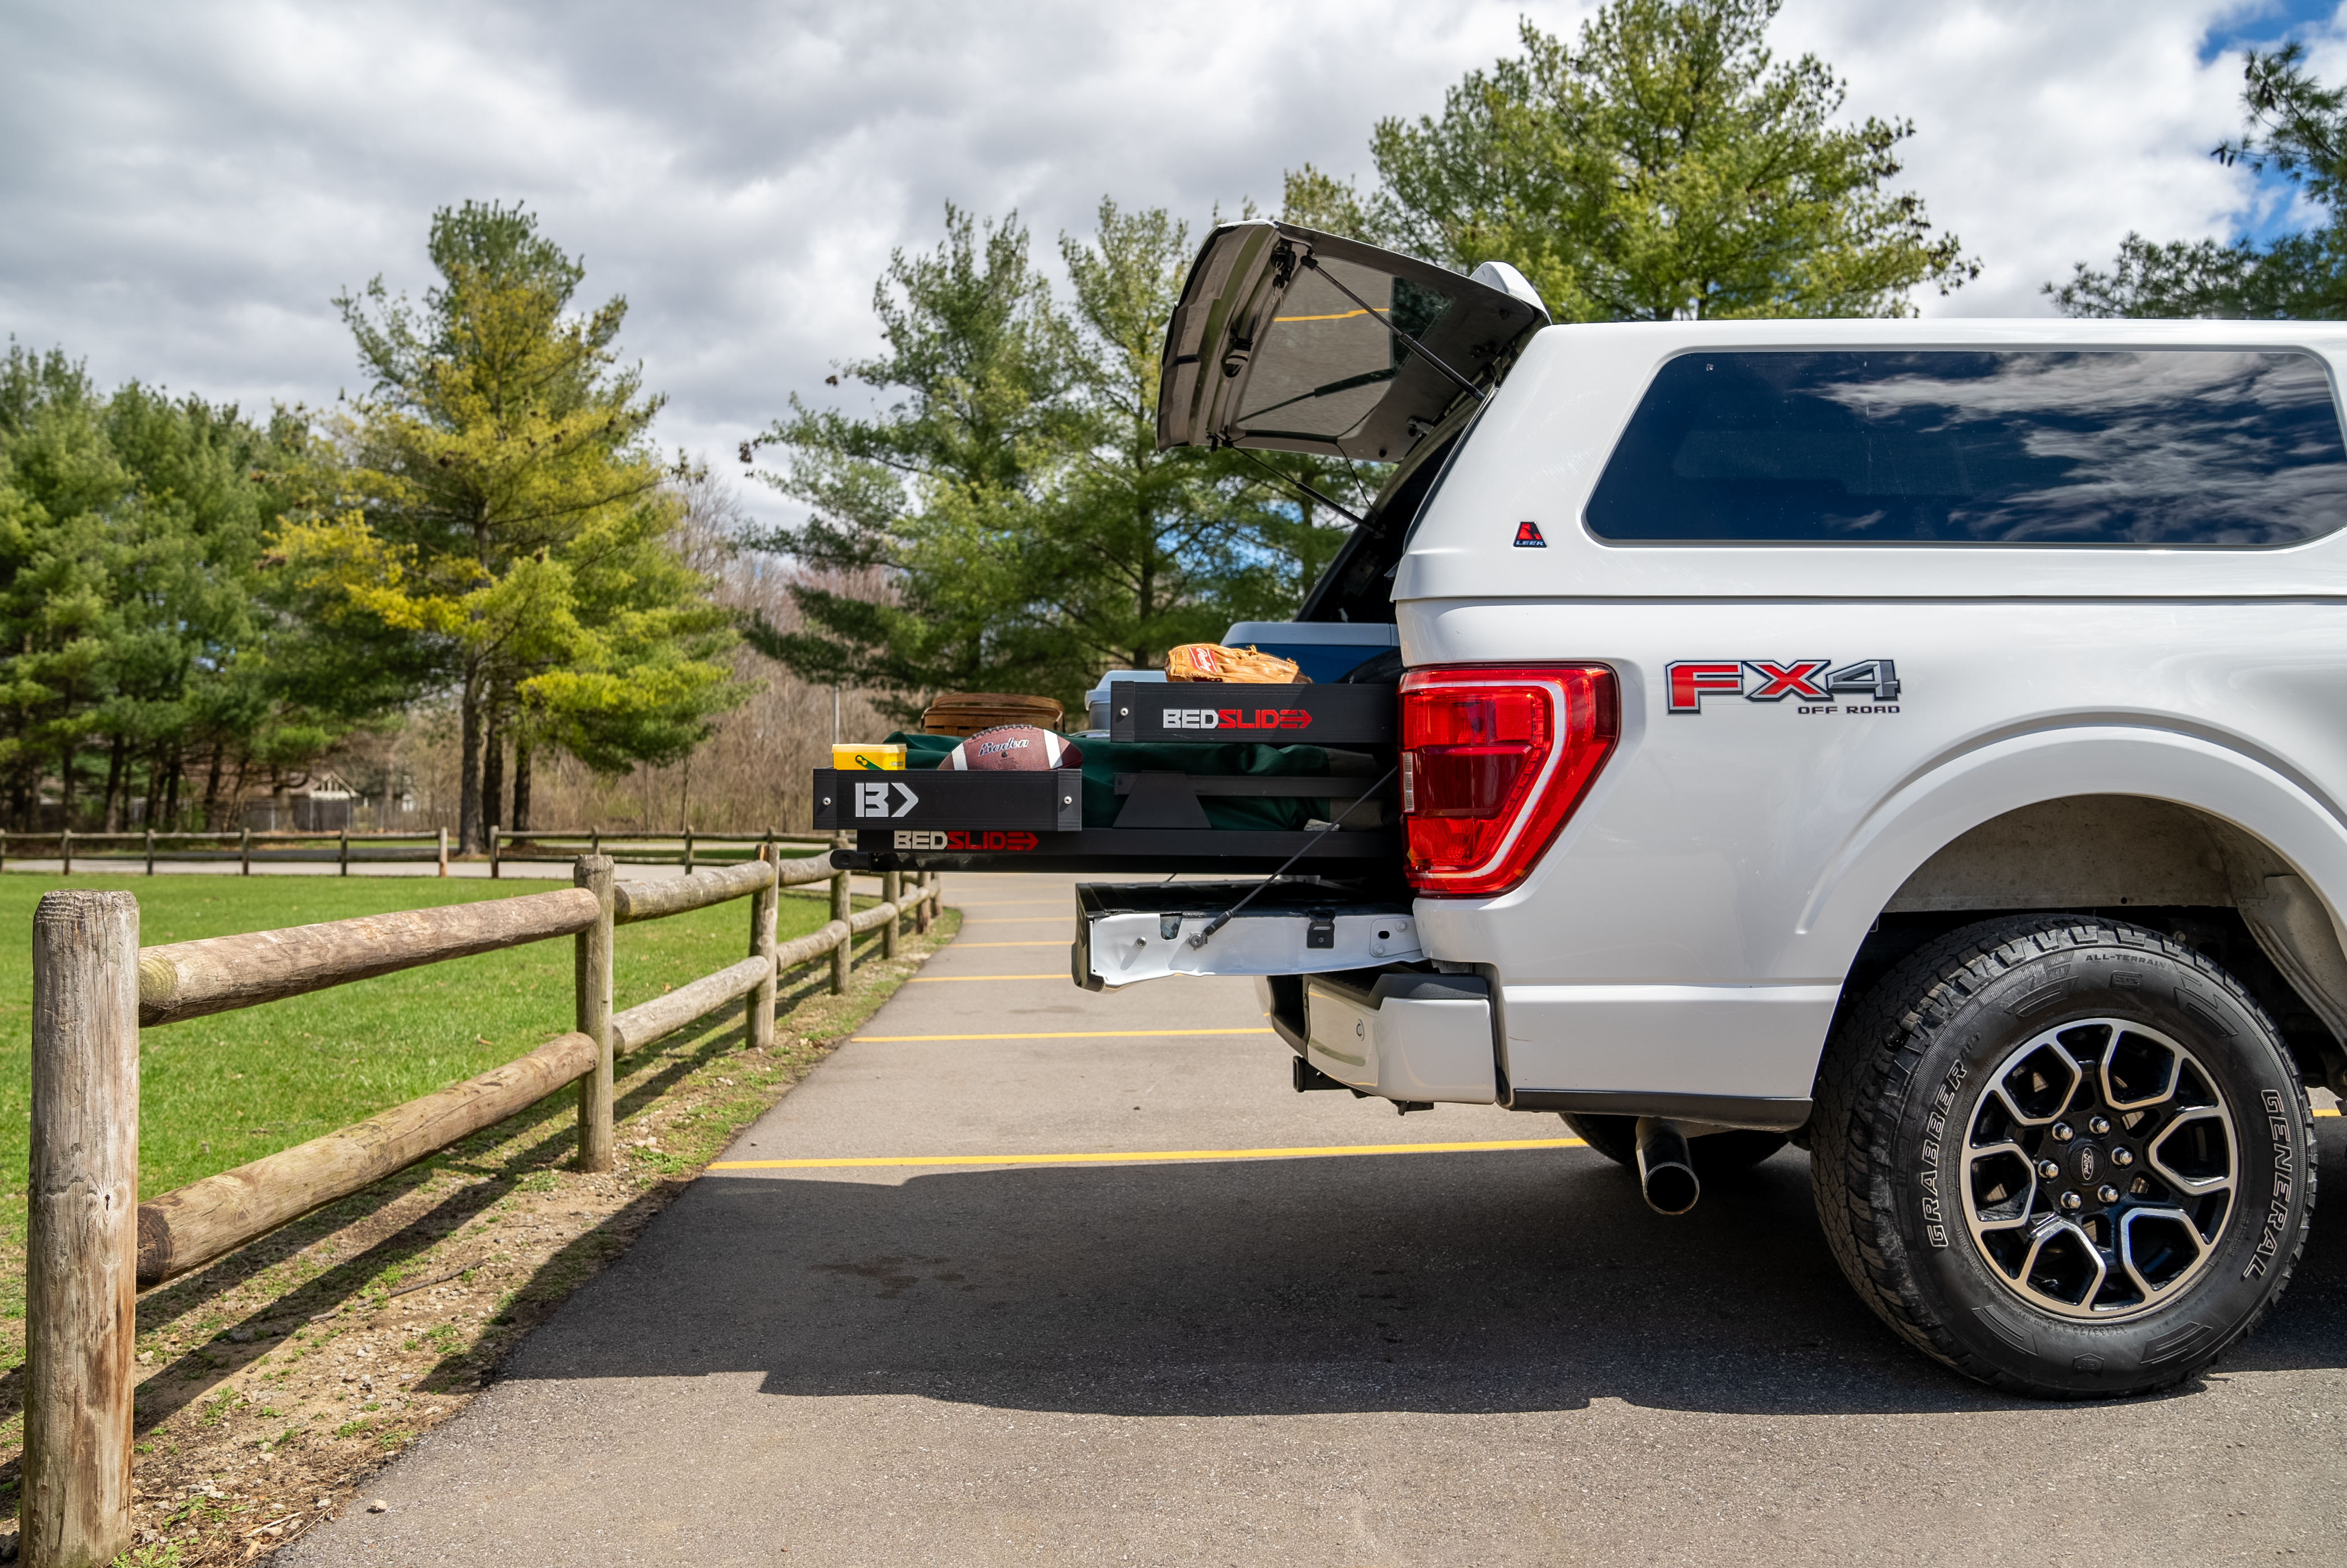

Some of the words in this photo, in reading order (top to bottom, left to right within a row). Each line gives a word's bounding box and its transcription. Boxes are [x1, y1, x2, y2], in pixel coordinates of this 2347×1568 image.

[1664, 659, 1902, 716] FX4
[1163, 708, 1312, 729] BEDSLIDE
[1797, 706, 1838, 715] OFF
[1845, 705, 1901, 715] ROAD
[978, 737, 1030, 757] Baden
[894, 830, 1038, 851] BEDSLIDE
[2085, 954, 2167, 968] ALL-TERRAIN
[1920, 1059, 1968, 1248] GRABBER
[2083, 1153, 2092, 1175] Ford
[2243, 1089, 2293, 1278] GENERAL
